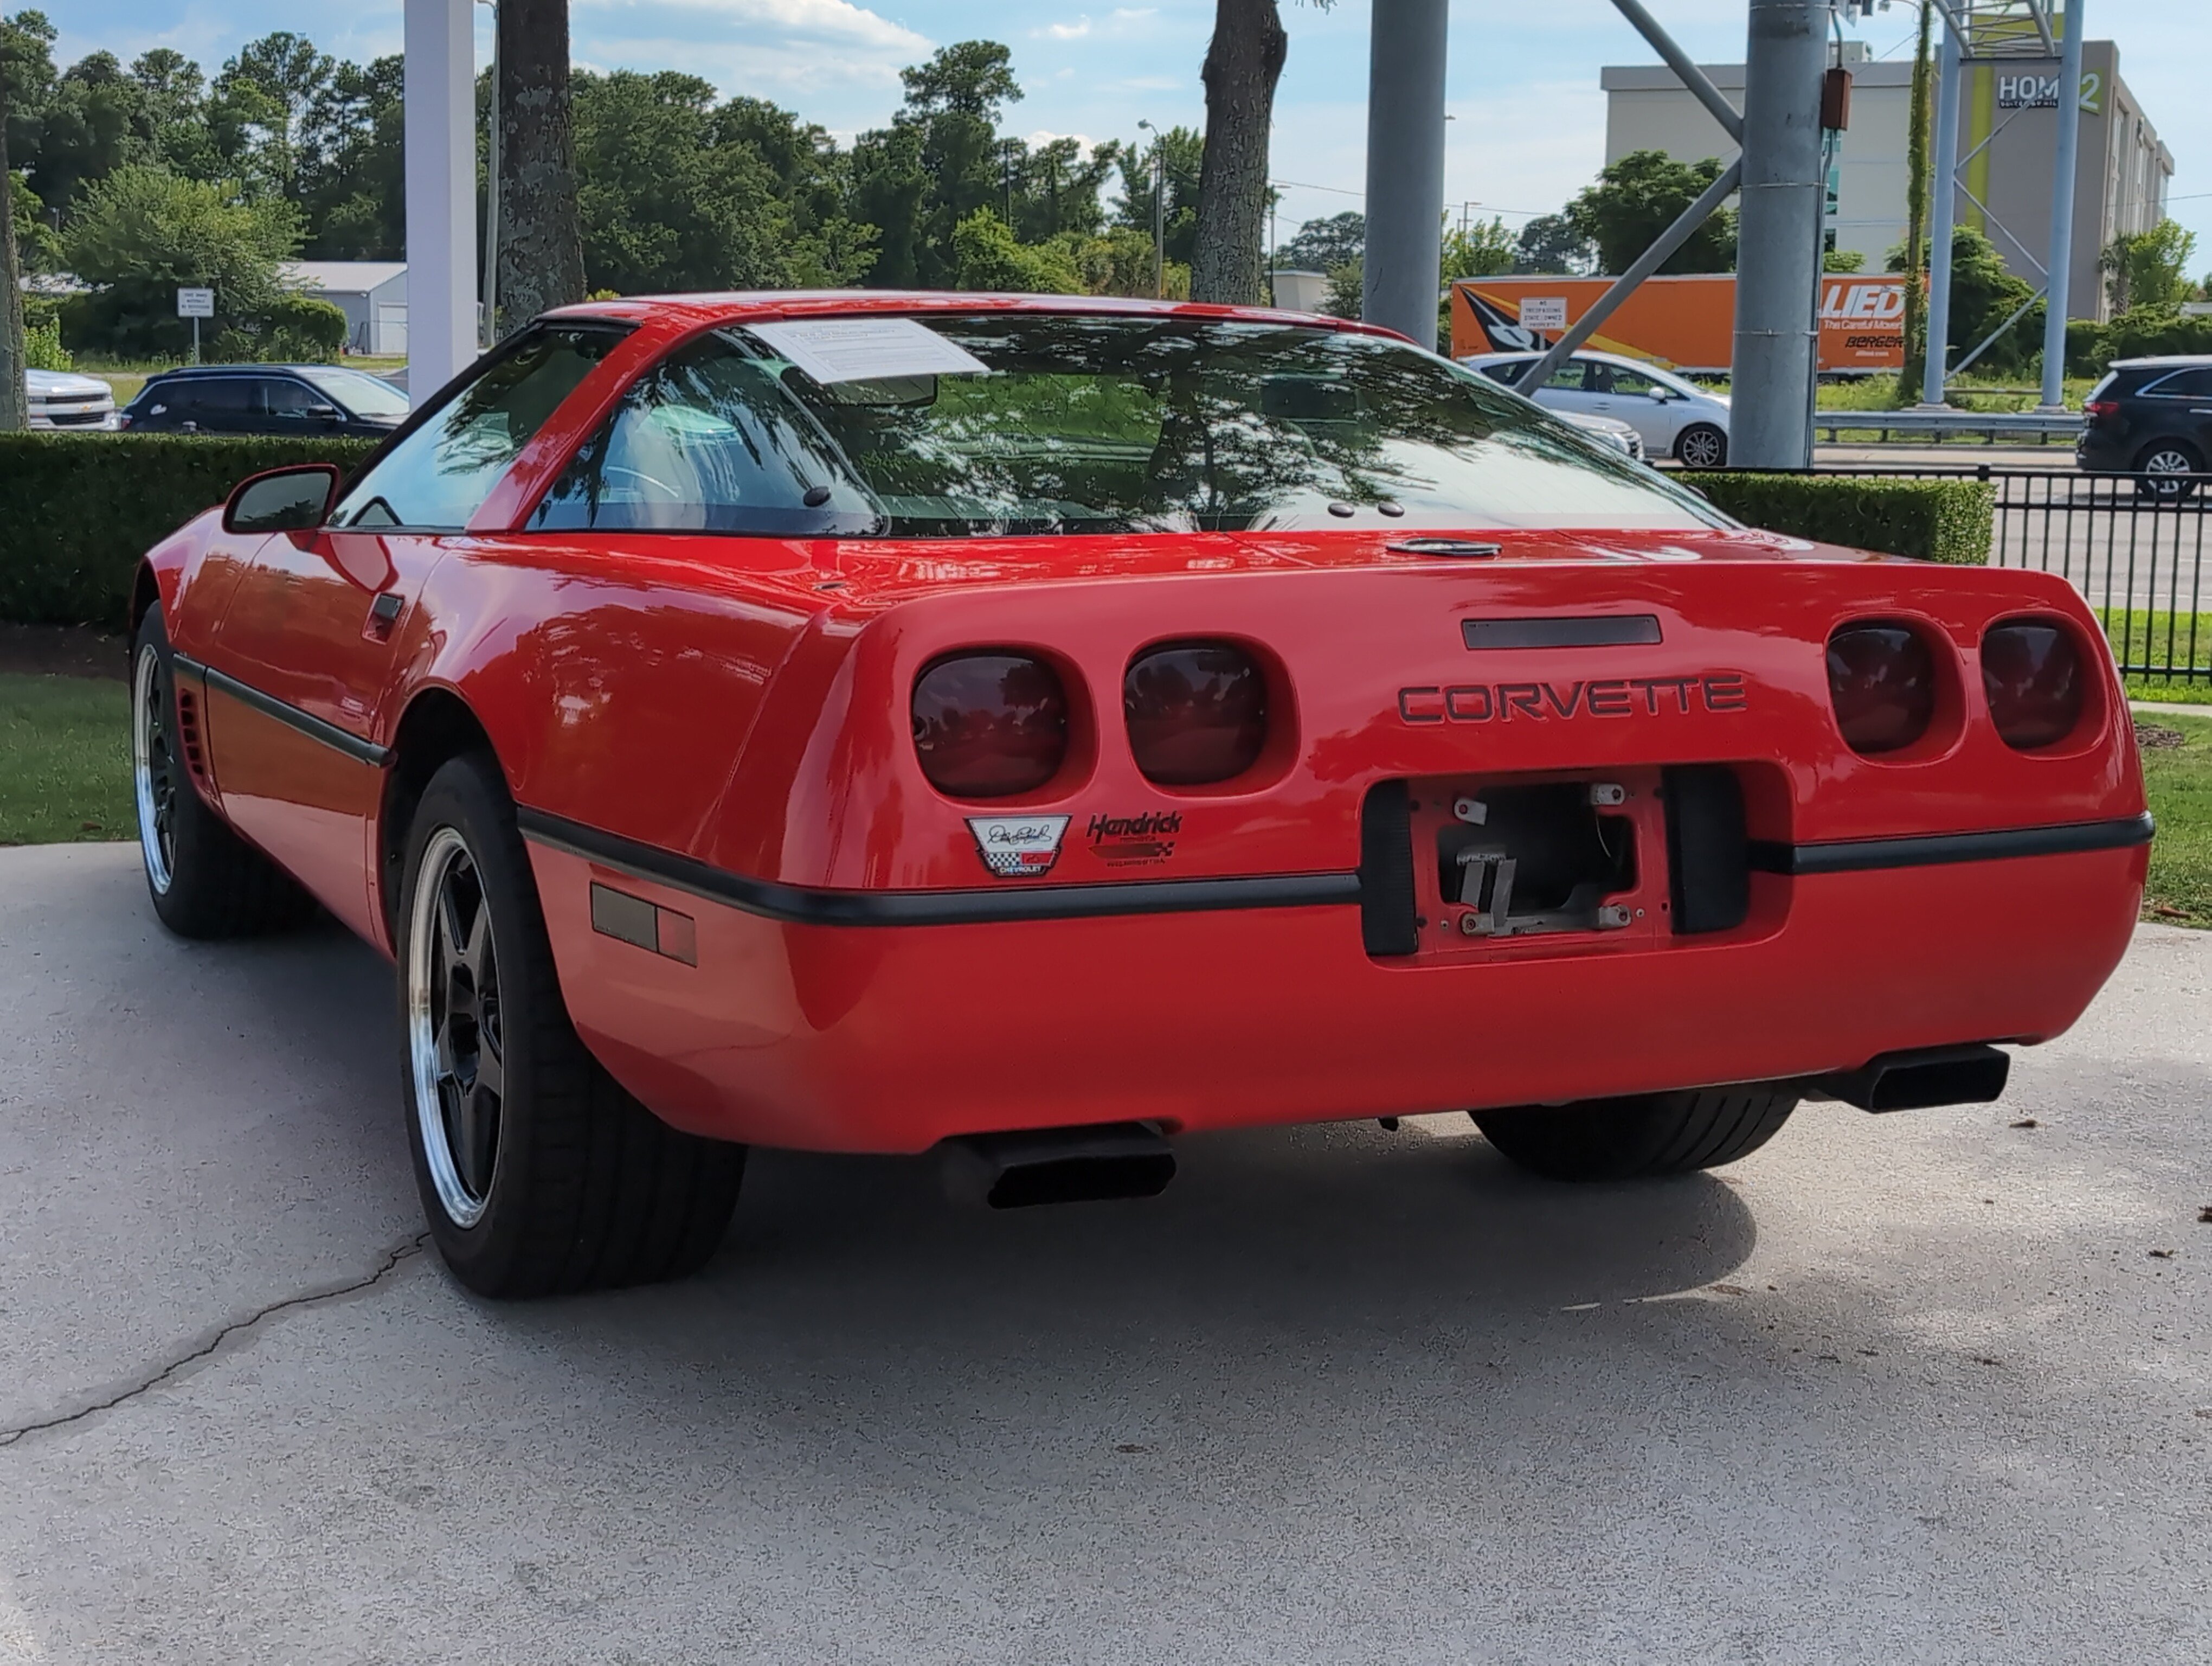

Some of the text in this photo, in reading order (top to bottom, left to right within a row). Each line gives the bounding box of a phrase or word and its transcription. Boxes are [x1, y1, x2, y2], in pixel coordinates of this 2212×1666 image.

[1999, 76, 2059, 99] HOM
[1818, 285, 1905, 318] LIED
[1825, 320, 1840, 330] The
[1397, 675, 1747, 723] CORVETTE
[1086, 810, 1183, 844] Hendrick
